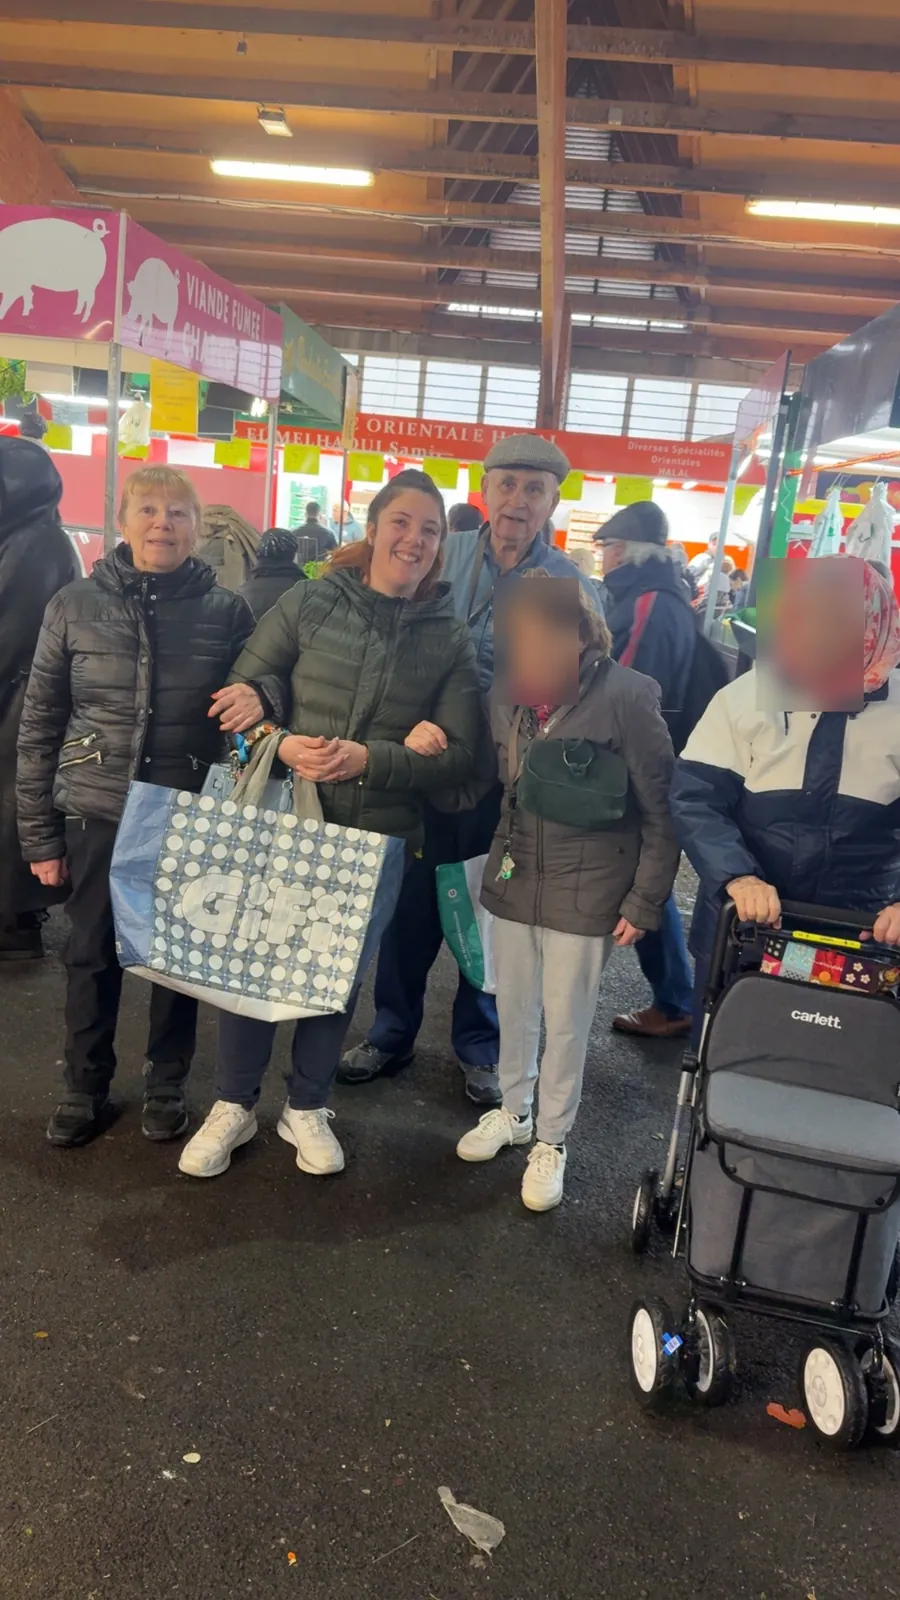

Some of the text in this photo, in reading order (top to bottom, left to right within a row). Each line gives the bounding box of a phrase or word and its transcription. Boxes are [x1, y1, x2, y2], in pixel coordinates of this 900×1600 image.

[186, 271, 230, 324] VIANDE
[366, 418, 484, 443] ORIENTALE
[628, 441, 725, 458] Diverses Spécialités
[651, 455, 701, 467] Orientales
[658, 467, 690, 477] HALAL
[791, 1010, 842, 1029] carlett.
